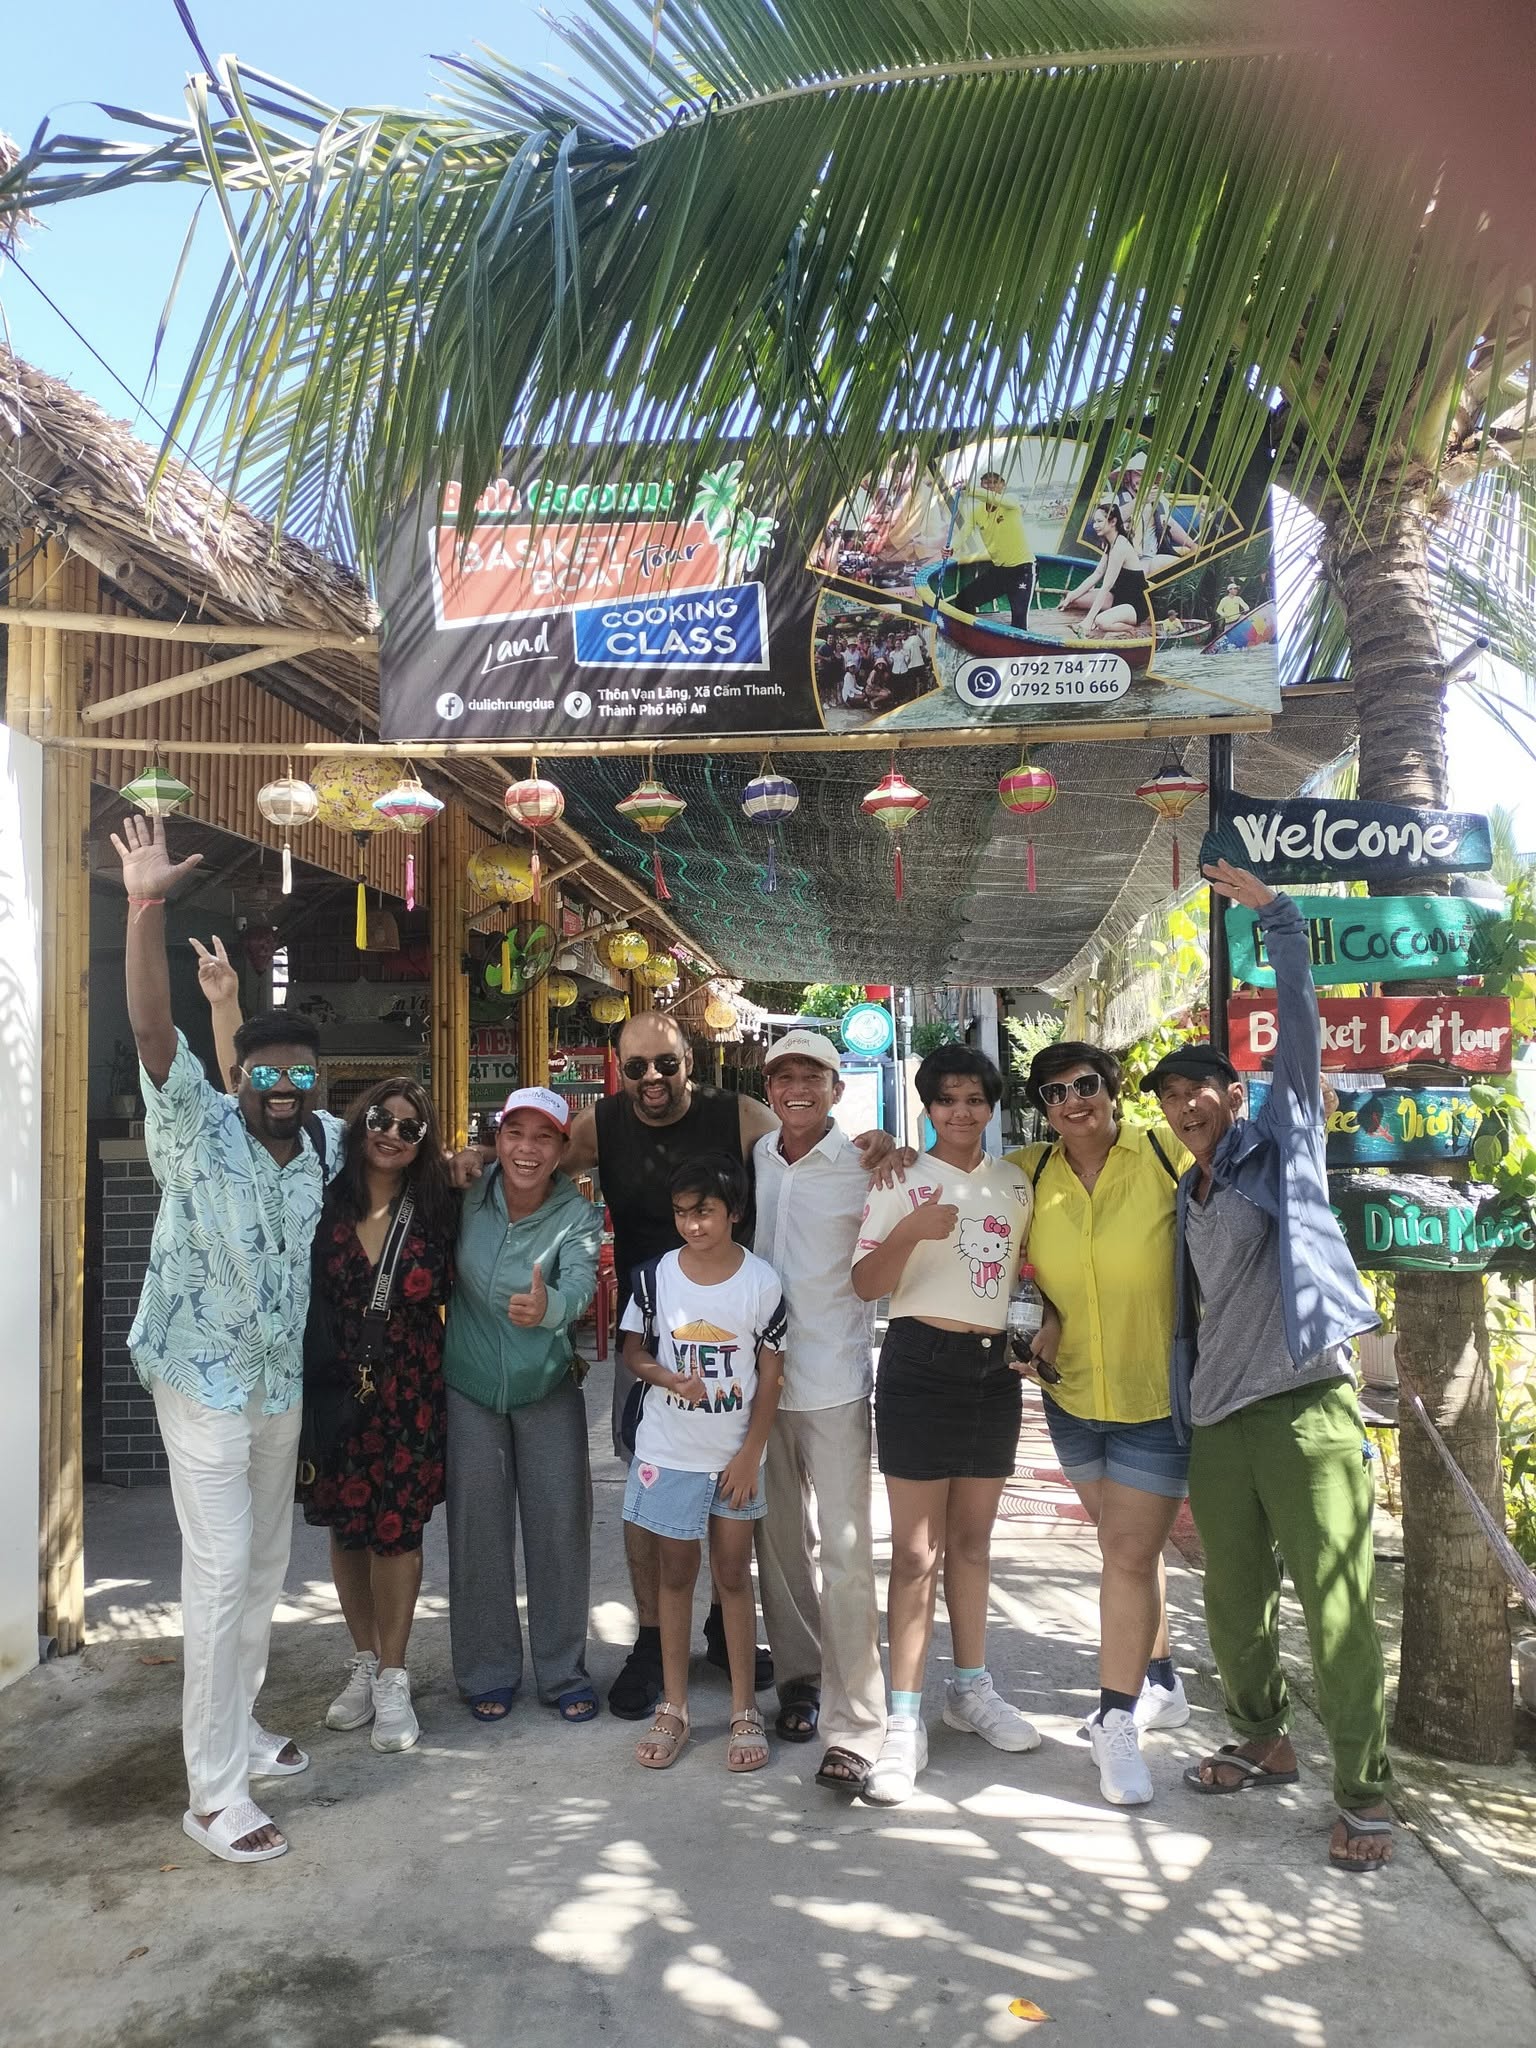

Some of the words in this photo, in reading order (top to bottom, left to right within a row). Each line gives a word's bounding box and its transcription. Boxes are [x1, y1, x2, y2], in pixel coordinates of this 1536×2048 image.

[439, 479, 522, 514] Bnh
[527, 479, 677, 514] Coconut
[455, 535, 626, 573] BASKET
[631, 543, 703, 578] tour
[532, 563, 631, 596] BOAT
[601, 597, 739, 628] COOKING
[606, 626, 738, 657] CLASS
[1010, 661, 1050, 676] 0792
[1054, 660, 1084, 674] 784
[1088, 659, 1118, 673] 777
[468, 697, 555, 712] dulichrungdua
[598, 688, 629, 701] Thôn
[631, 688, 655, 702] Vạn
[657, 687, 691, 701] Lăng,
[694, 685, 711, 698] Xã
[744, 683, 786, 698] Thanh,
[1011, 682, 1050, 697] 0792
[1055, 681, 1084, 695] 510
[1089, 680, 1119, 693] 666
[598, 704, 636, 717] Thành
[639, 702, 664, 716] Phố
[666, 702, 687, 717] Hội
[690, 702, 707, 715] An
[1233, 809, 1459, 862] Welcome
[1249, 1011, 1367, 1054] Bket
[1380, 1015, 1444, 1056] boat
[1365, 1194, 1444, 1252] Dừa
[672, 1340, 741, 1378] VIET
